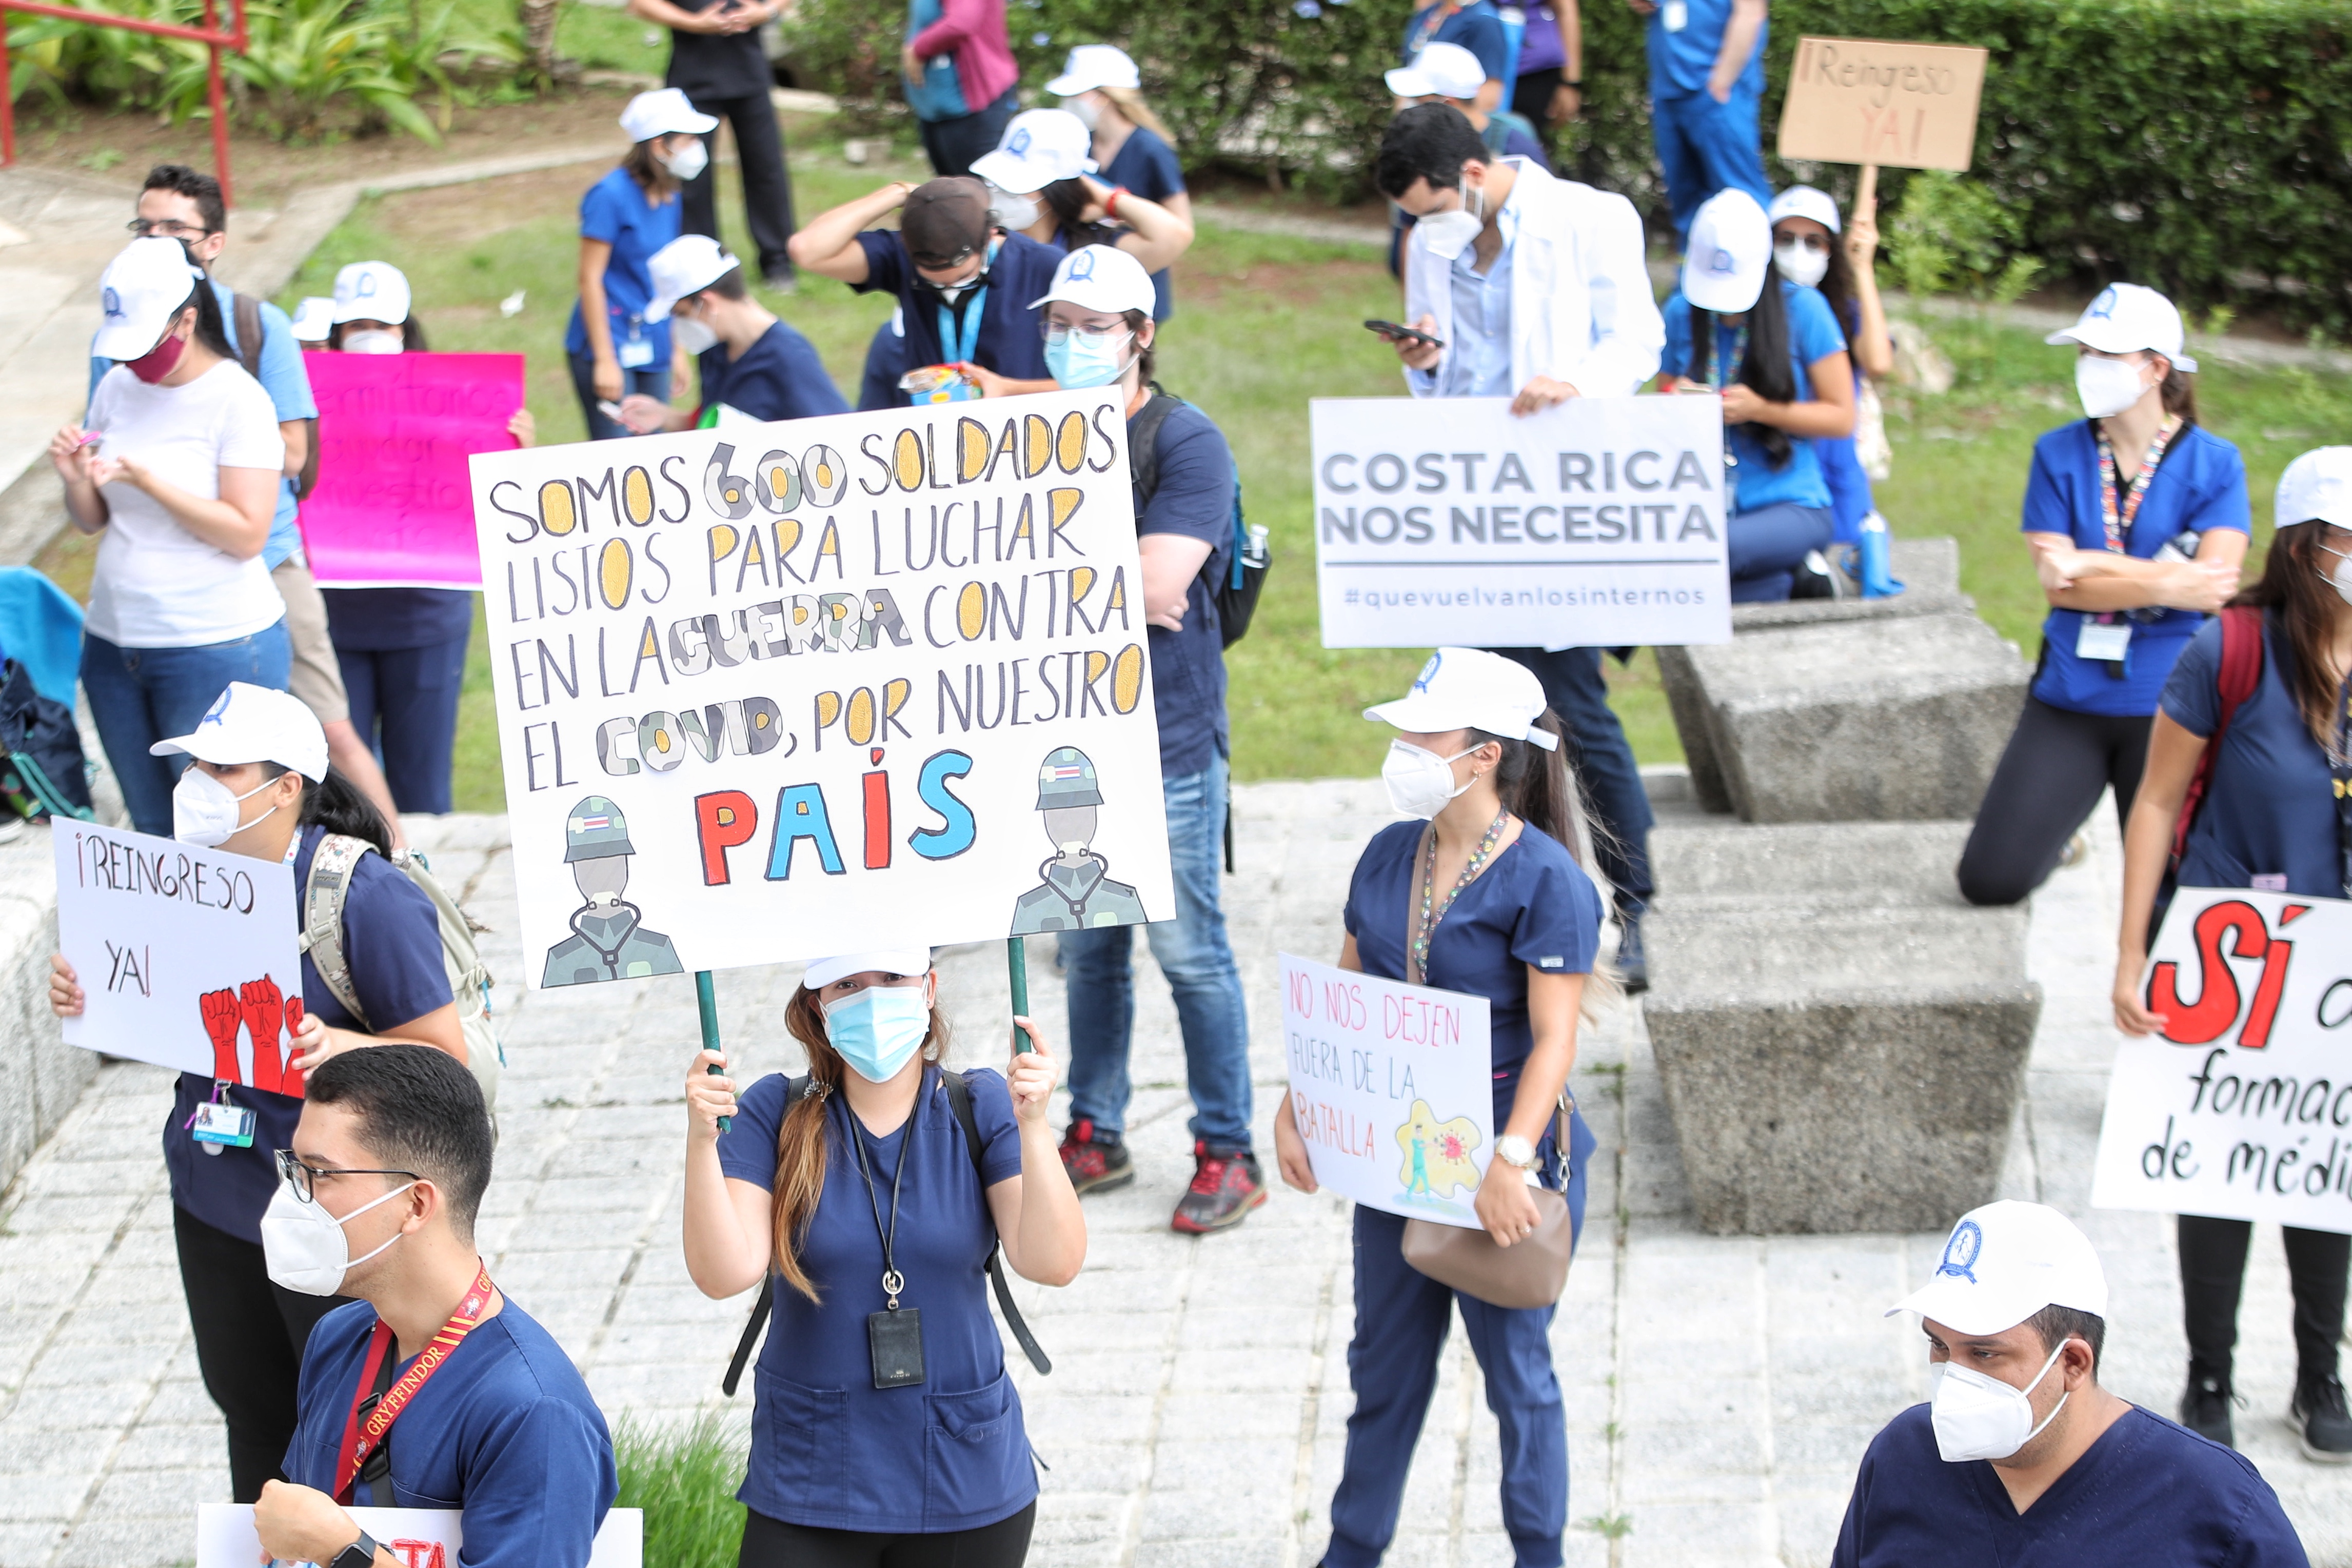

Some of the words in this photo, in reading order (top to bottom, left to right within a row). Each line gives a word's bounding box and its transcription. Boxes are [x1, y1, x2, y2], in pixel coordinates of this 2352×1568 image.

[1860, 107, 1926, 160] YA!
[490, 456, 690, 543] SOMOS
[703, 442, 847, 519] 600
[859, 403, 1117, 496] SOLDADOS
[1321, 452, 1534, 494] COSTA
[1558, 450, 1712, 492] RICA
[506, 532, 671, 623] LISTOS
[707, 515, 843, 597] PARA
[872, 487, 1086, 576] LUCHAR
[1323, 506, 1433, 545] NOS
[1451, 504, 1716, 544] NECESITA
[510, 634, 578, 710] EN
[599, 616, 669, 697] LA
[668, 588, 913, 676] GUERRA
[924, 566, 1129, 649] CONTRA
[1344, 586, 1705, 610] #quevuelvanlosinternos
[524, 721, 579, 791] EL
[596, 696, 797, 776] COVID,
[815, 678, 913, 752] POR
[938, 643, 1144, 734] NUESTRO
[694, 747, 977, 886] PAÍS
[76, 832, 255, 915] ¡REINGRESO
[105, 939, 150, 998] YA!
[1289, 970, 1314, 1020] NO
[1325, 981, 1367, 1031] NOS
[1383, 994, 1460, 1047] DEJEN
[1292, 1032, 1343, 1086] FUERA
[1353, 1050, 1376, 1094] DE
[1389, 1057, 1416, 1100] LA
[1297, 1092, 1376, 1163] BATALLA
[2141, 1115, 2200, 1183] de
[2227, 1135, 2352, 1203] médi
[367, 1346, 446, 1437] GRYFFINDOR
